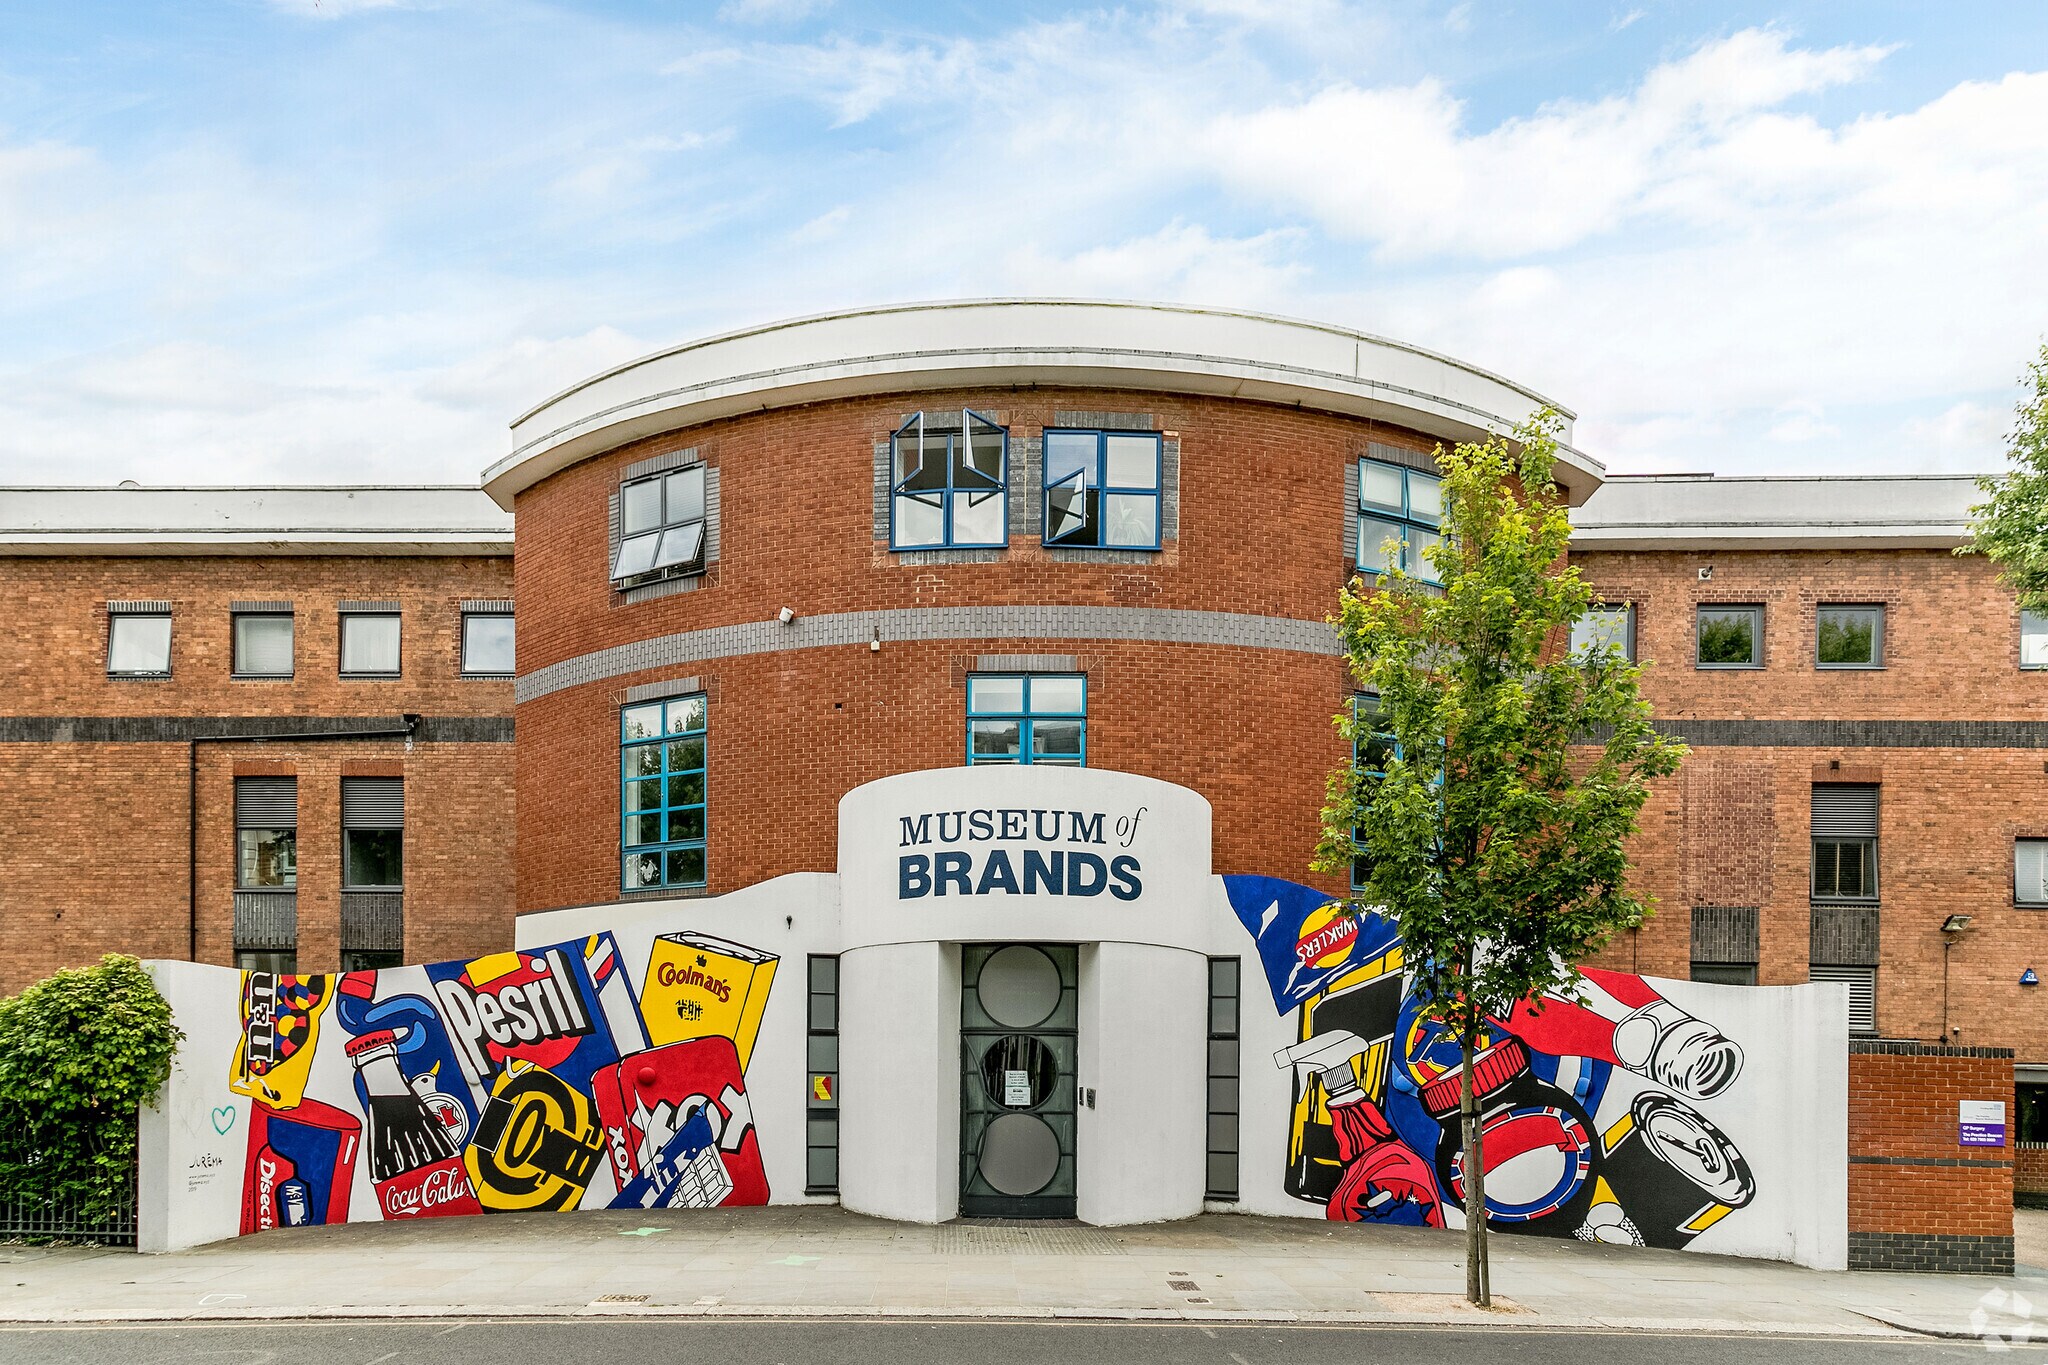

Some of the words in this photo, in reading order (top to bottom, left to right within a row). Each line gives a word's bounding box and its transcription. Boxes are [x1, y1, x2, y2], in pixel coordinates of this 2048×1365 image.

[899, 808, 1107, 848] MUSEUM
[1115, 806, 1148, 848] of
[898, 849, 1143, 901] BRANDS
[1296, 917, 1358, 962] WAKLERS
[657, 961, 732, 1003] Coolman's
[436, 949, 587, 1076] Pesril
